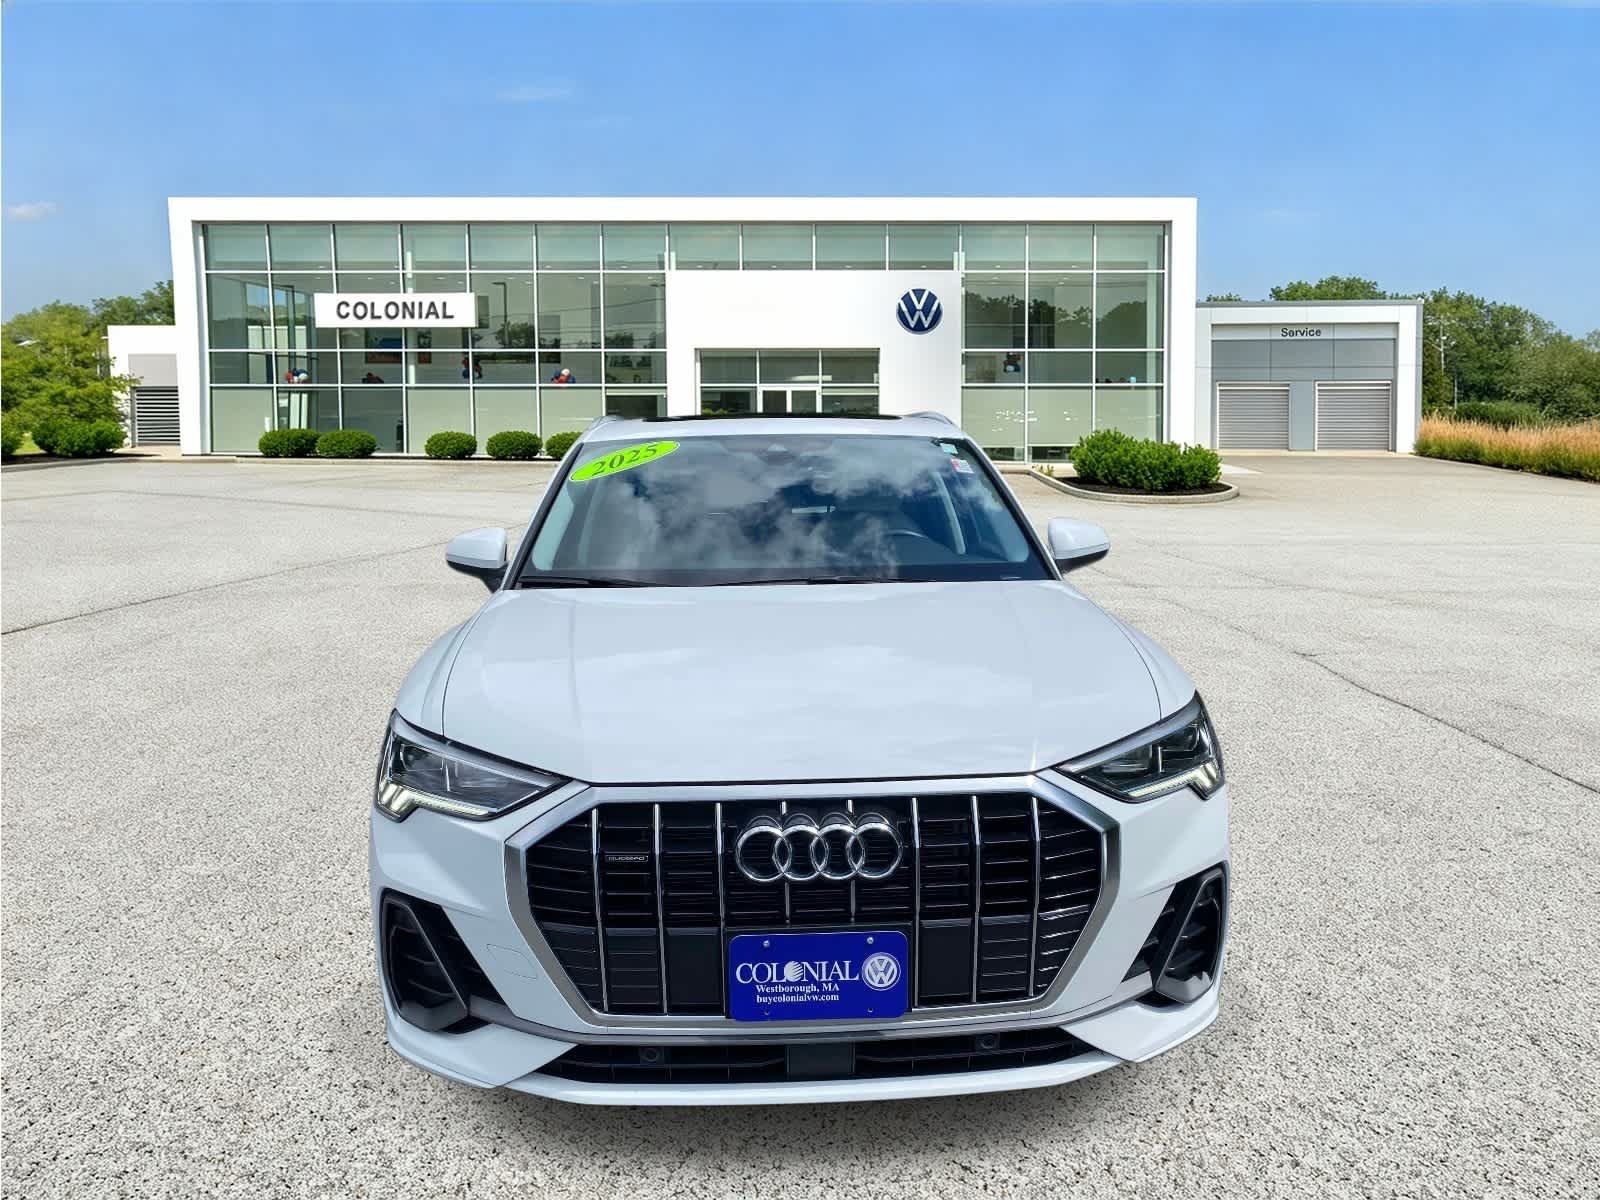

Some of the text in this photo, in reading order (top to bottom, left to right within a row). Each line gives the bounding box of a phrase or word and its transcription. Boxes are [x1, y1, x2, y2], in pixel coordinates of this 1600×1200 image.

[336, 301, 454, 320] COLONIAL
[1280, 327, 1321, 338] Service
[592, 444, 657, 476] 2025
[735, 960, 859, 984] COLONIAL
[756, 982, 840, 995] Westborough, MA
[756, 992, 840, 1005] buycolonialvw.com
